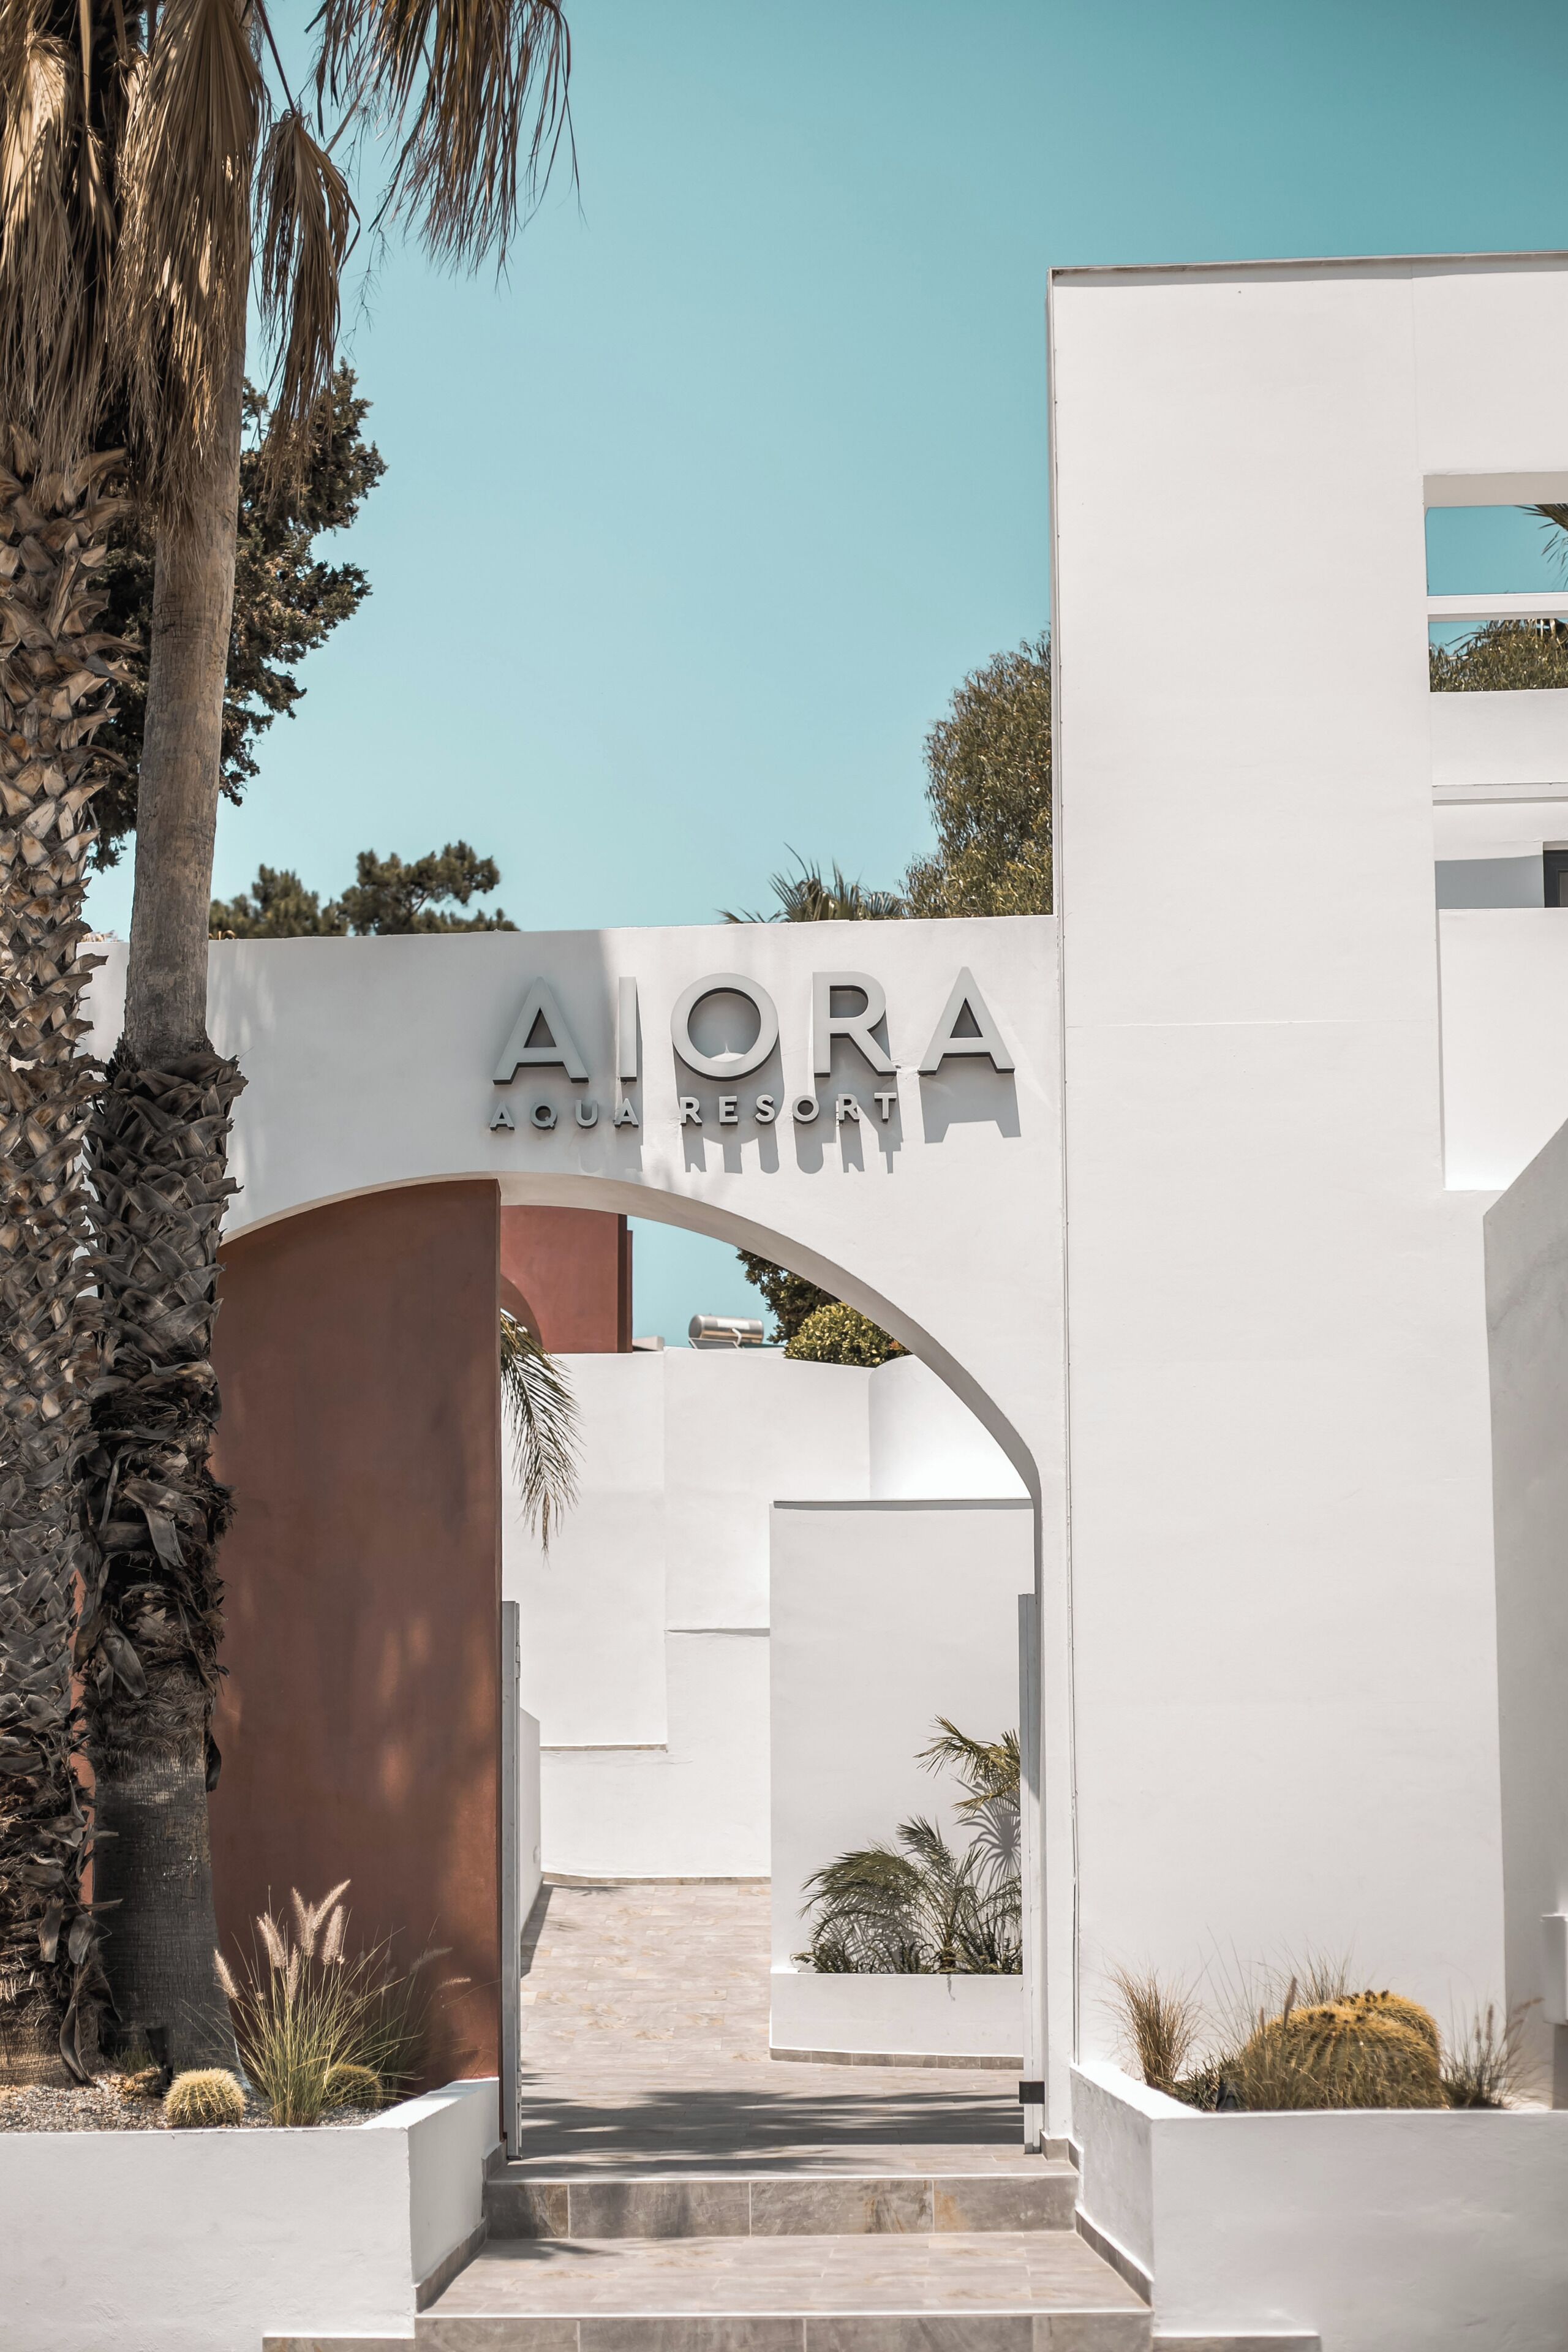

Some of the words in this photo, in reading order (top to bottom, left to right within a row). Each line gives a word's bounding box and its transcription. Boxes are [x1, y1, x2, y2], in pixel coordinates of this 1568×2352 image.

[492, 966, 1015, 1085] AIORA
[489, 1098, 639, 1131] AQUA
[679, 1092, 897, 1126] RESORT
